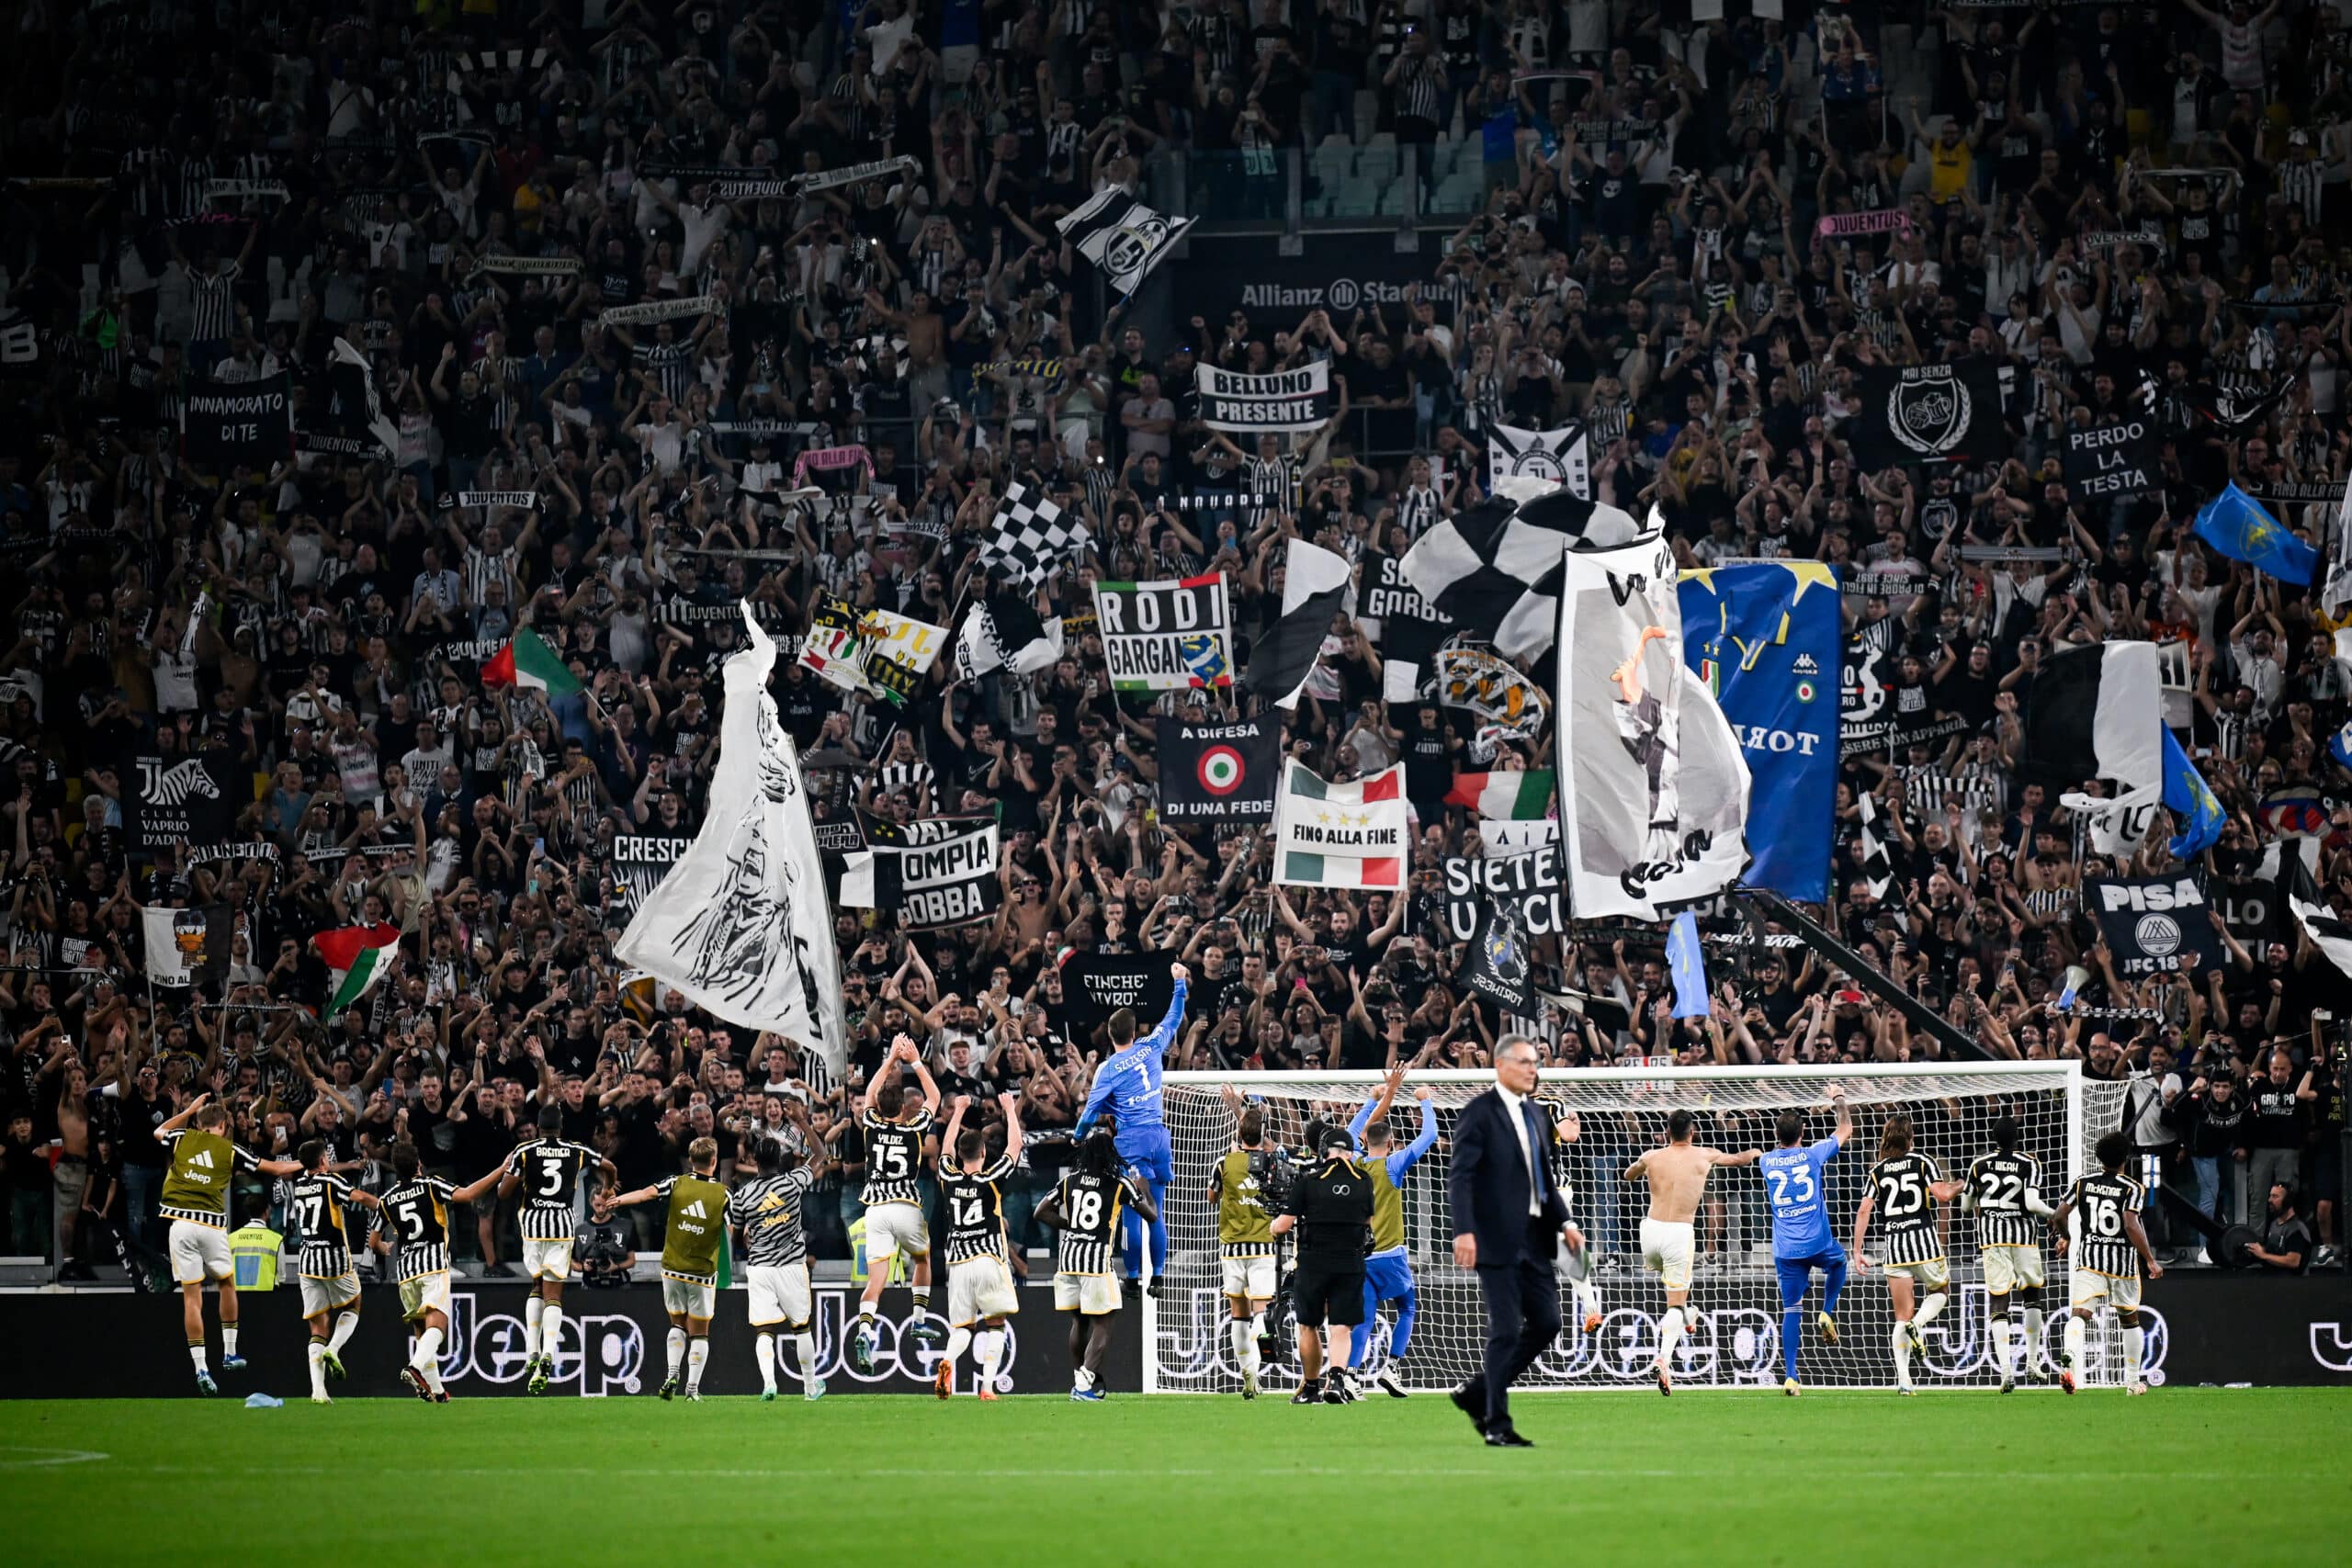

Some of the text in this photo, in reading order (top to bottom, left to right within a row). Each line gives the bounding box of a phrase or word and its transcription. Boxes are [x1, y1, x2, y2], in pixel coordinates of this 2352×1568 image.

[1832, 210, 1903, 232] JUVENTUS
[1242, 283, 1323, 307] Allianz
[1902, 364, 1952, 379] MAI SENZA
[1214, 370, 1312, 396] BELLUNO
[190, 392, 284, 416] INNAMORATO
[1216, 399, 1315, 423] PRESENTE
[220, 423, 258, 443] DI TE
[2070, 422, 2145, 451] PERDO
[309, 434, 363, 455] JUVENTUS
[2096, 450, 2125, 470] LA
[2079, 468, 2149, 496] TESTA
[2271, 482, 2347, 499] FINO ALLA FIN
[465, 492, 530, 506] JUVENTUS
[689, 603, 742, 621] JUVENTU
[1100, 584, 1222, 634] RODI
[1109, 633, 1225, 675] GARGANO
[1181, 723, 1260, 739] A DIFESA
[412, 760, 440, 771] UNITI
[140, 809, 188, 819] CLUB
[1167, 800, 1273, 816] DI UNA FEDE
[141, 820, 191, 832] VAPRIO
[1294, 825, 1398, 844] FINO ALLA FINE
[142, 833, 191, 846] D'ADDA
[903, 836, 990, 883] OMPIA
[1446, 847, 1558, 897] SIETE
[2100, 878, 2204, 913] PISA
[1452, 888, 1566, 942] UCI
[2124, 953, 2202, 974] JFC 18
[153, 975, 175, 986] FINO
[1083, 975, 1148, 989] FINCHE'
[1134, 1062, 1151, 1091] 1
[2260, 1092, 2296, 1106] GRUPO
[876, 1134, 904, 1146] YILDIZ
[536, 1146, 571, 1158] BREMER
[873, 1145, 909, 1178] 15
[1765, 1153, 1808, 1168] PINSOGLIO
[183, 1168, 211, 1185] Jeep
[1883, 1159, 1913, 1174] RABIOT
[1995, 1160, 2019, 1173] WEAH
[538, 1158, 563, 1197] 3
[1766, 1164, 1815, 1206] 23
[386, 1188, 425, 1206] LOCATELLI
[954, 1189, 978, 1199] MILIK
[1879, 1172, 1923, 1217] 25
[1979, 1172, 2023, 1210] 22
[297, 1196, 323, 1236] 27
[949, 1197, 986, 1226] 14
[1069, 1189, 1103, 1231] 18
[2085, 1195, 2121, 1237] 16
[399, 1201, 424, 1241] 5
[677, 1222, 706, 1236] Jeep
[761, 1212, 791, 1229] Jeep
